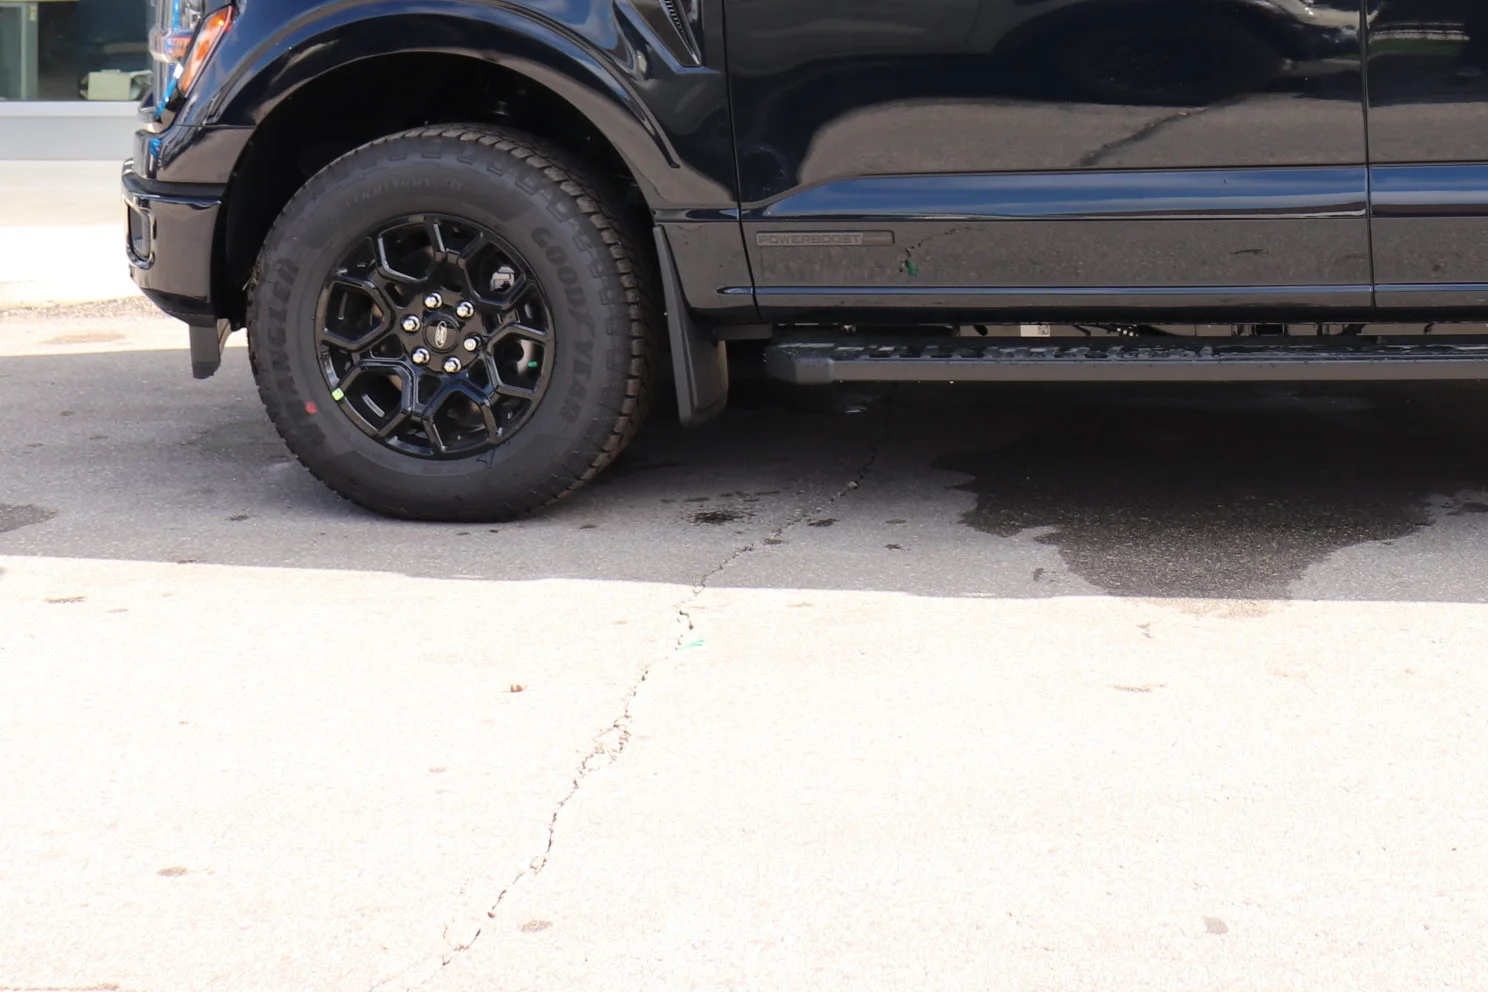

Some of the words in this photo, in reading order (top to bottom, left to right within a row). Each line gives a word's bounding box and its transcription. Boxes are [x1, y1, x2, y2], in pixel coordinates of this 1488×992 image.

[531, 226, 589, 426] GOODYEAR
[758, 233, 862, 245] POWERBOOST
[267, 258, 327, 446] WRANGLER
